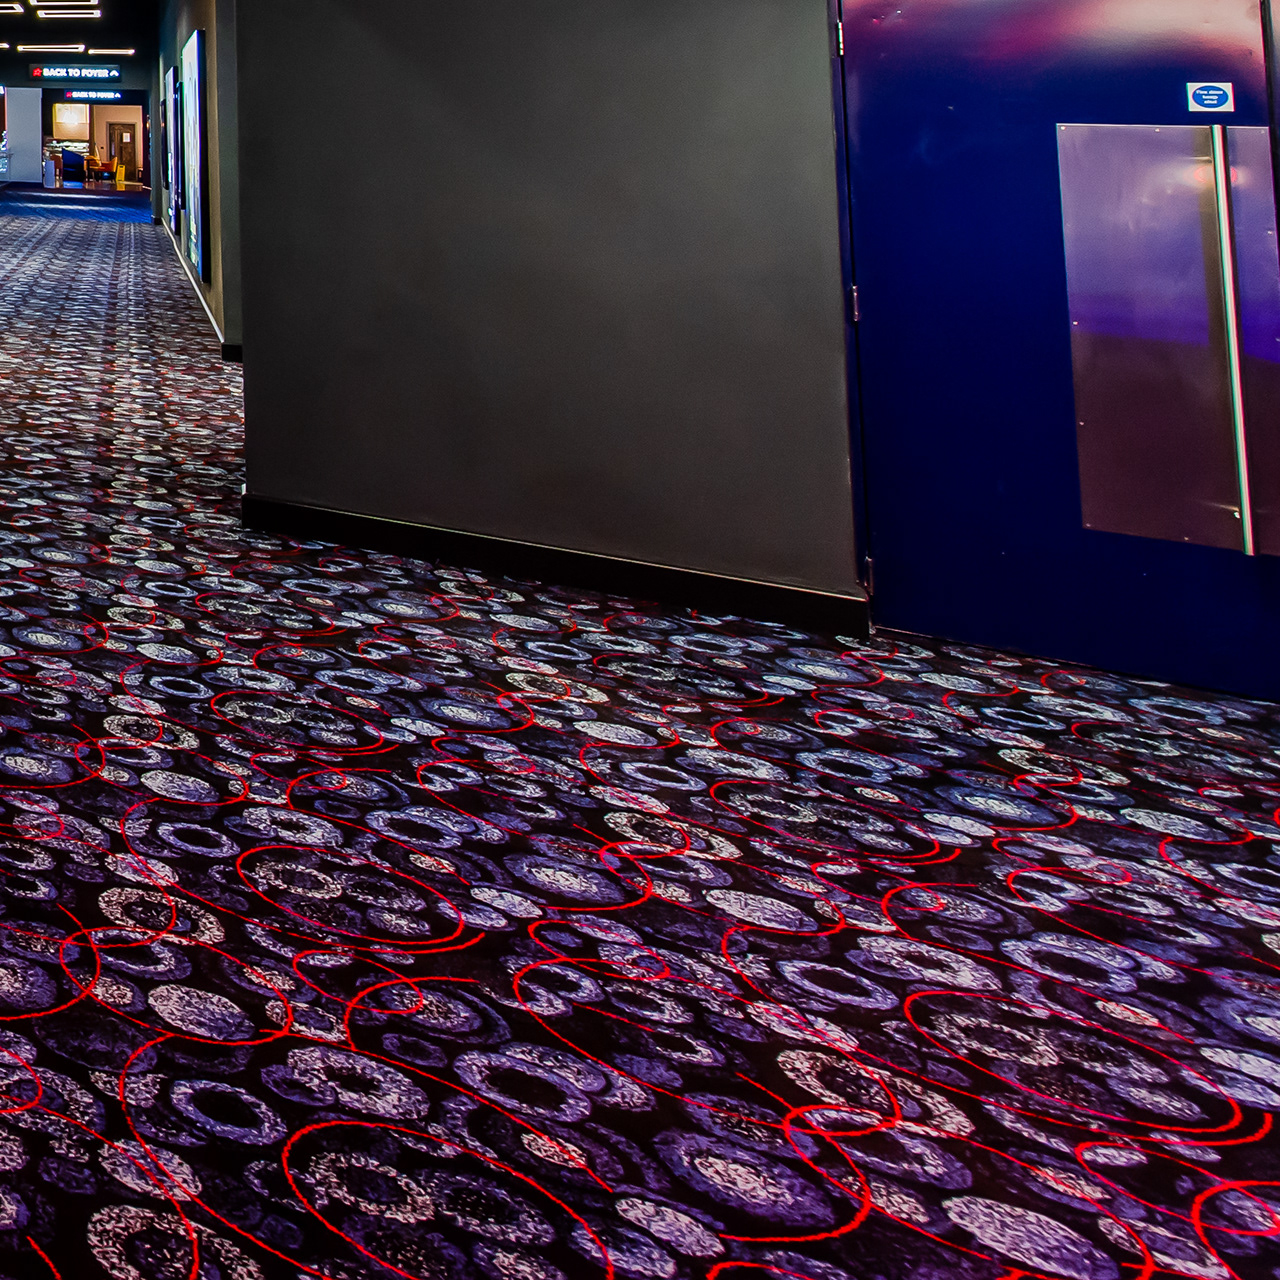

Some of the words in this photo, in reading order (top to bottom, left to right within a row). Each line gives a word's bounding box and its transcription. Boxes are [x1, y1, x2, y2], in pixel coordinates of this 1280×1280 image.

[43, 68, 67, 77] BACK
[68, 68, 80, 77] TO
[81, 69, 109, 78] FOYER
